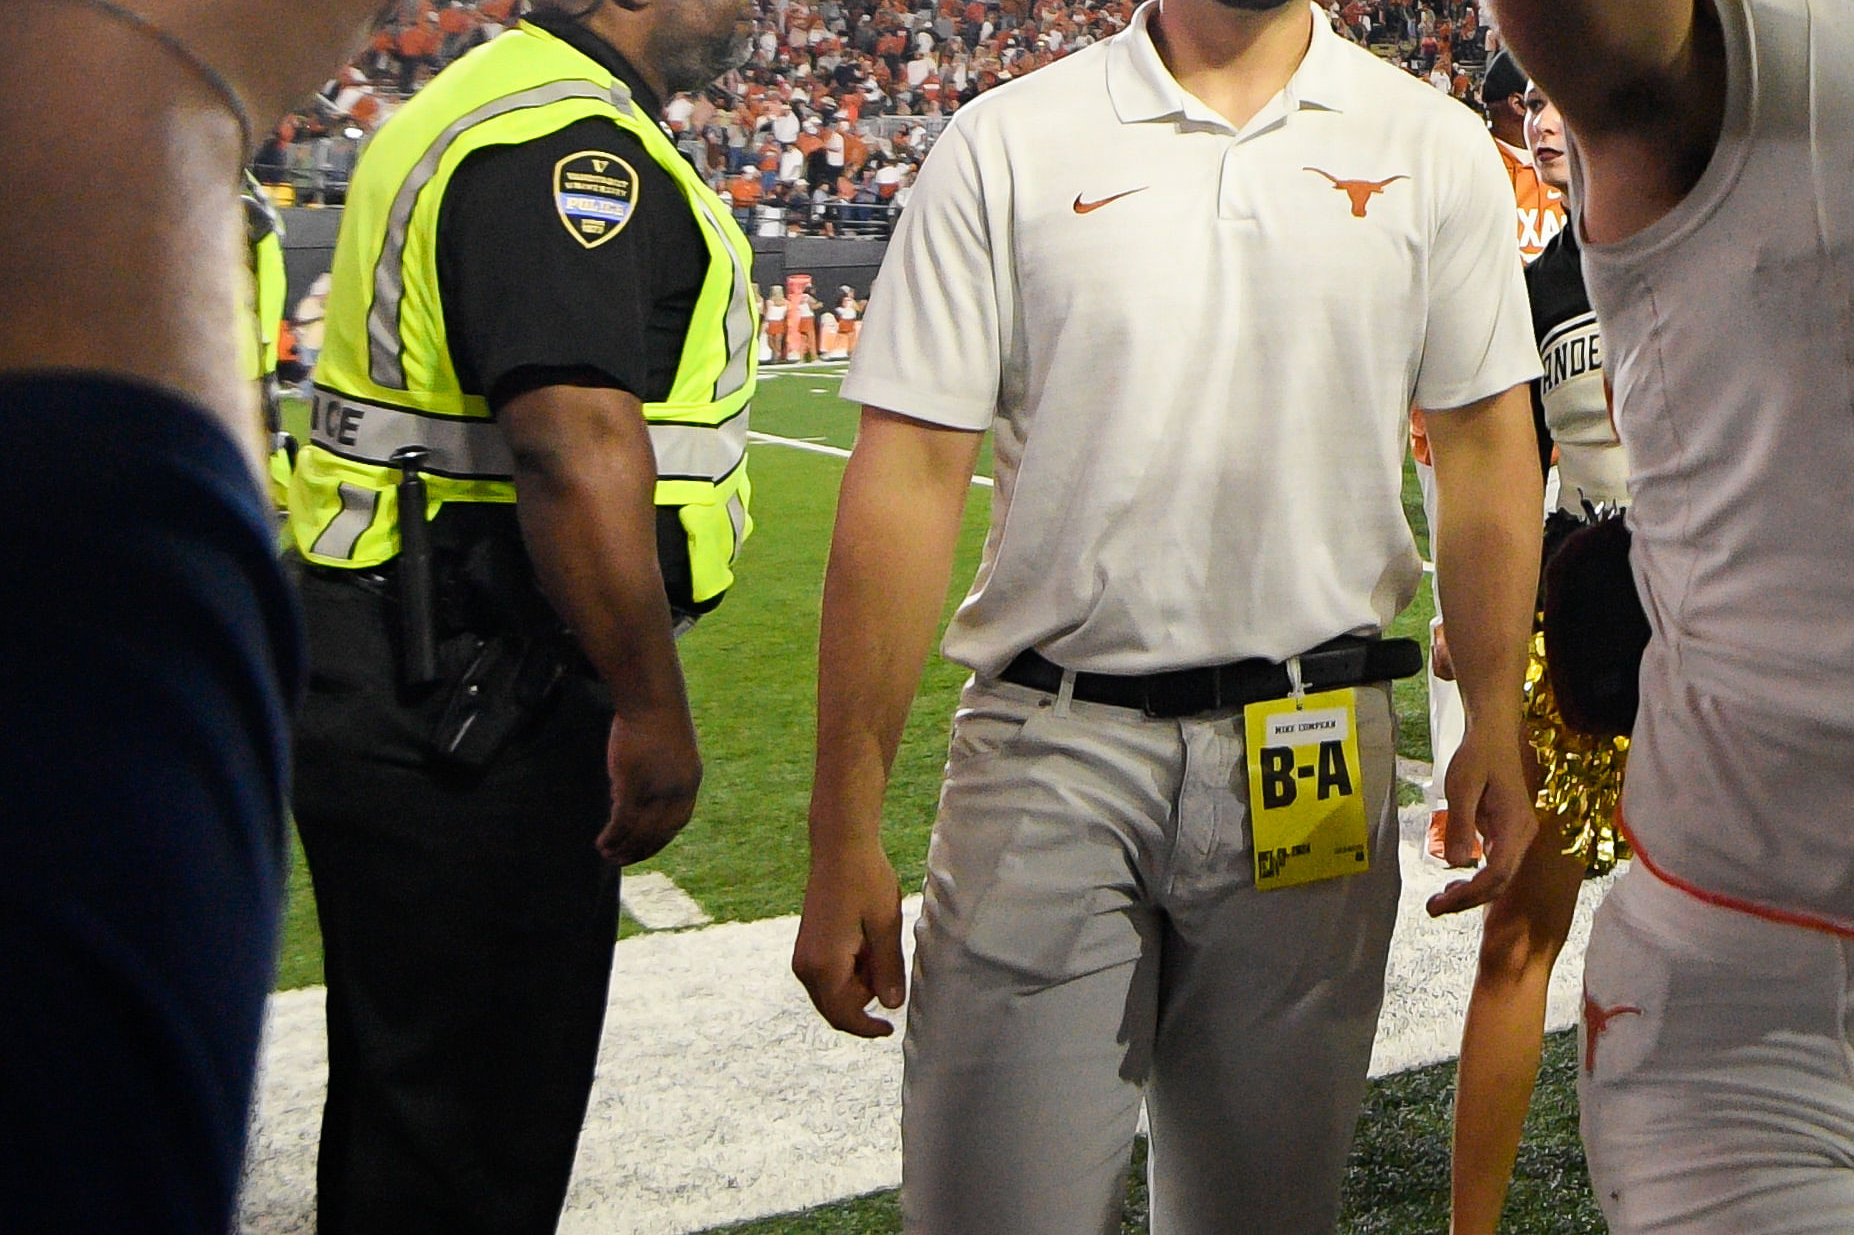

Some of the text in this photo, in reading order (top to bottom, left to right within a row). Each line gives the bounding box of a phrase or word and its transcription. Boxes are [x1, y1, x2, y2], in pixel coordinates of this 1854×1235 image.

[566, 197, 625, 217] POLICE
[1516, 208, 1568, 247] XA
[1260, 740, 1353, 810] B-A
